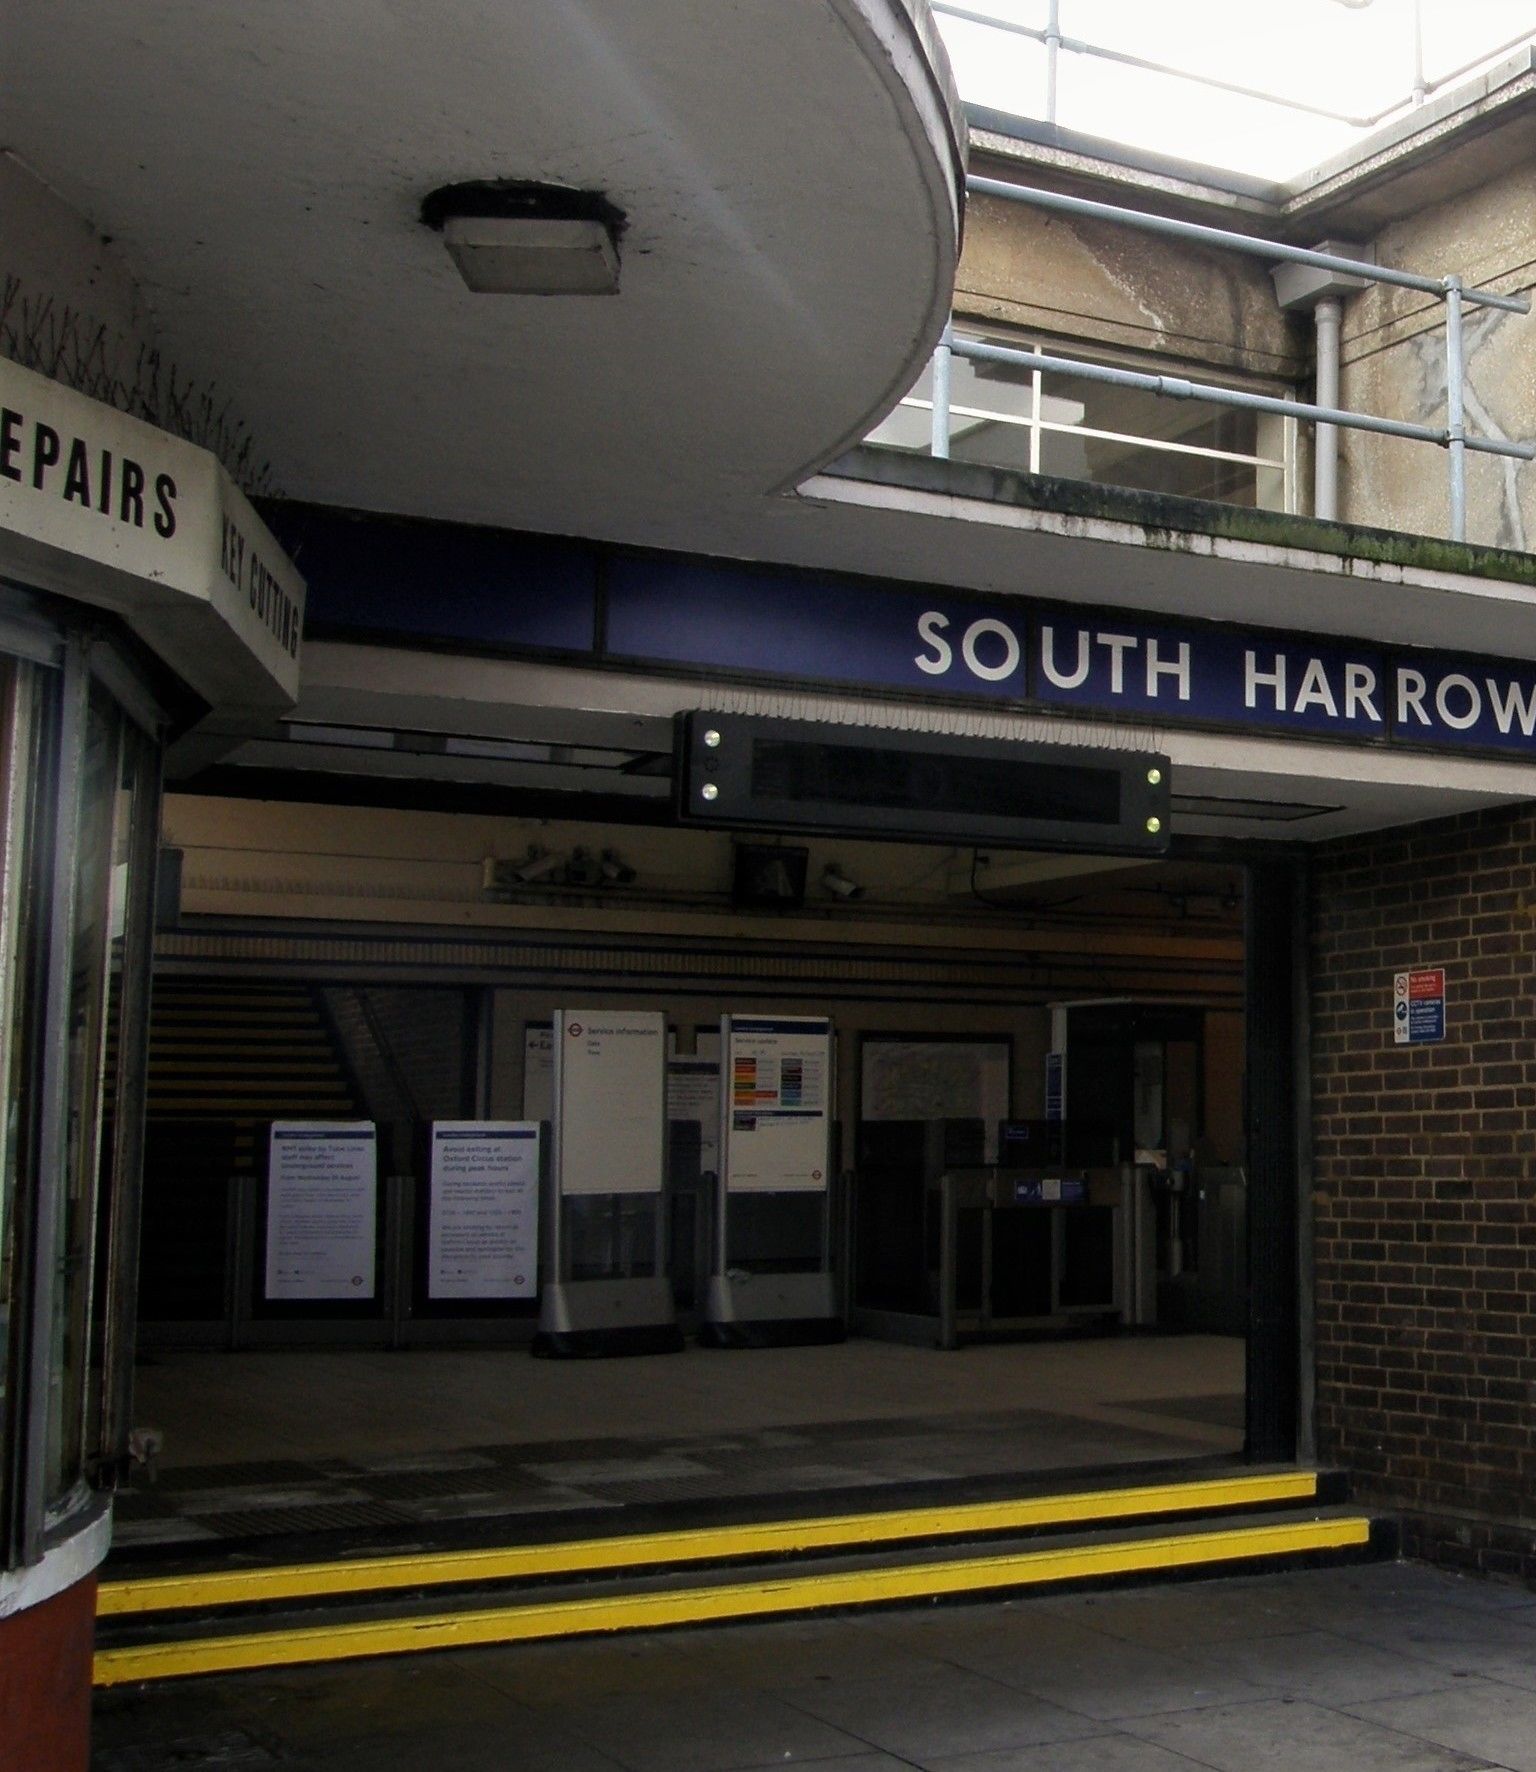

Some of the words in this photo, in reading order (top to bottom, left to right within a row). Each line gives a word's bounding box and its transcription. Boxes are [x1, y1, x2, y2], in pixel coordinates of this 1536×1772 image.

[221, 512, 245, 591] KEY
[250, 551, 299, 659] CUTTING
[914, 611, 1191, 700] SOUTH
